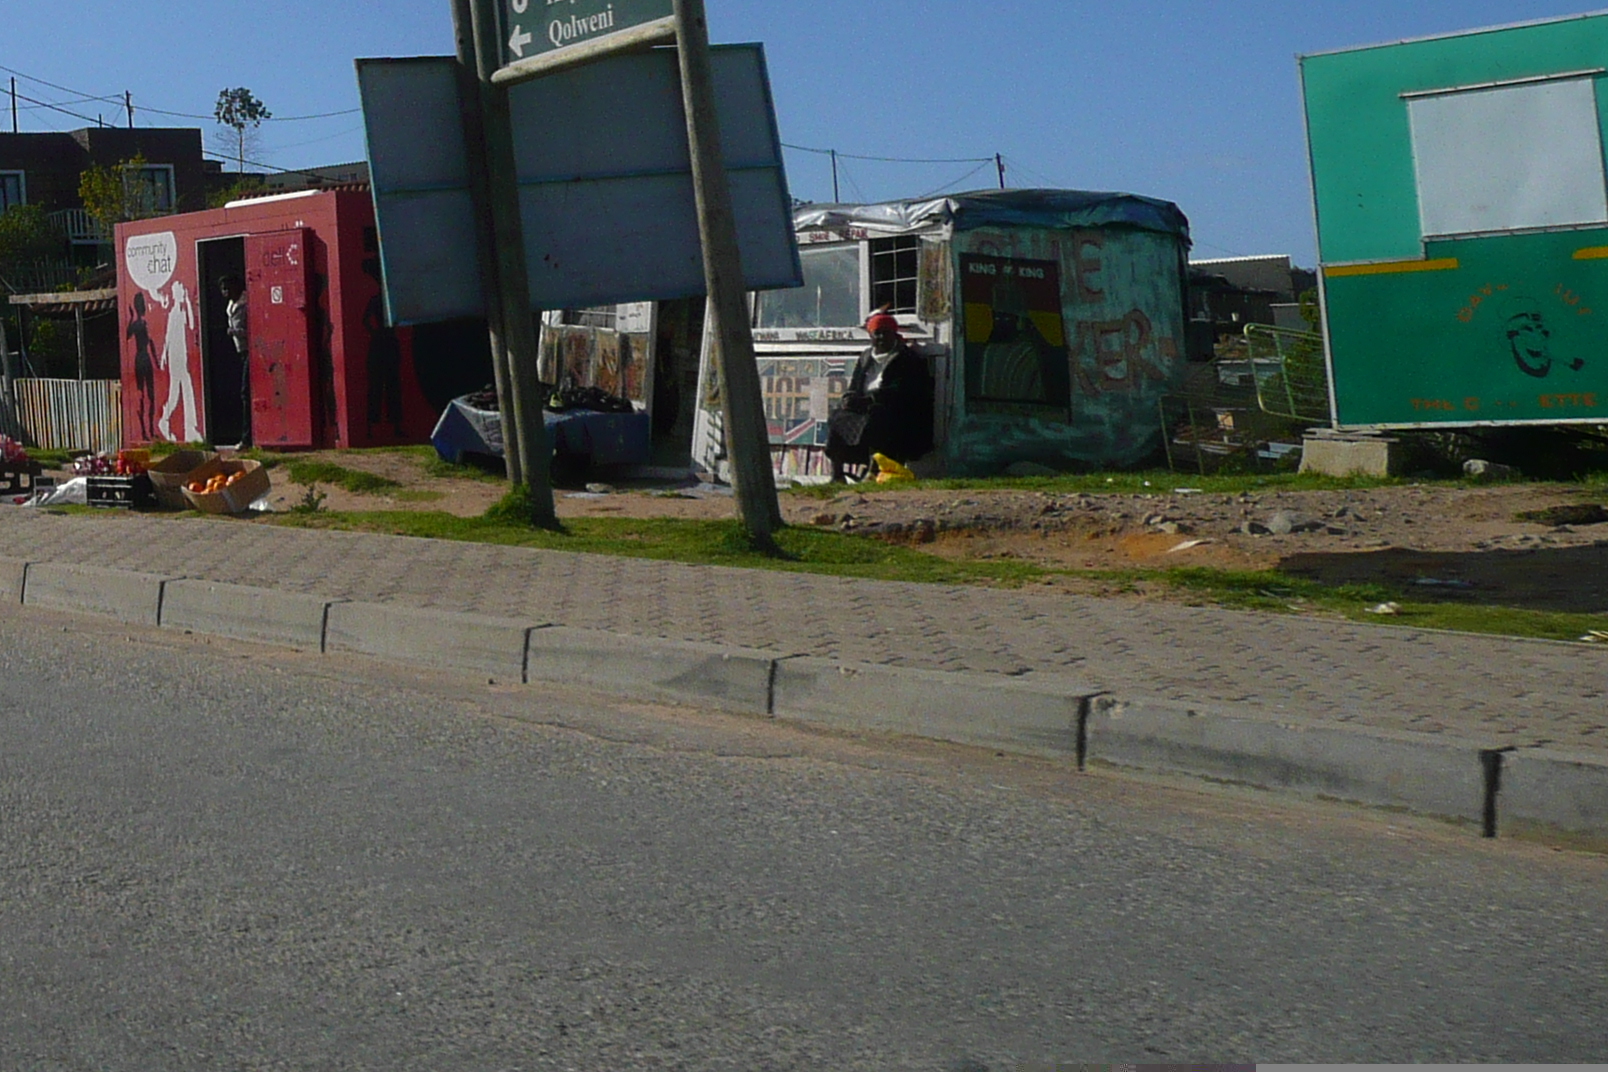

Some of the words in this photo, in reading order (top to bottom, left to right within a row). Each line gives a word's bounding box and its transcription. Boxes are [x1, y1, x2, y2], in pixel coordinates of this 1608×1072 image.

[549, 3, 614, 47] Qolweni
[127, 241, 167, 258] community
[147, 255, 171, 274] chat
[968, 262, 996, 276] KING
[1018, 267, 1045, 279] KING
